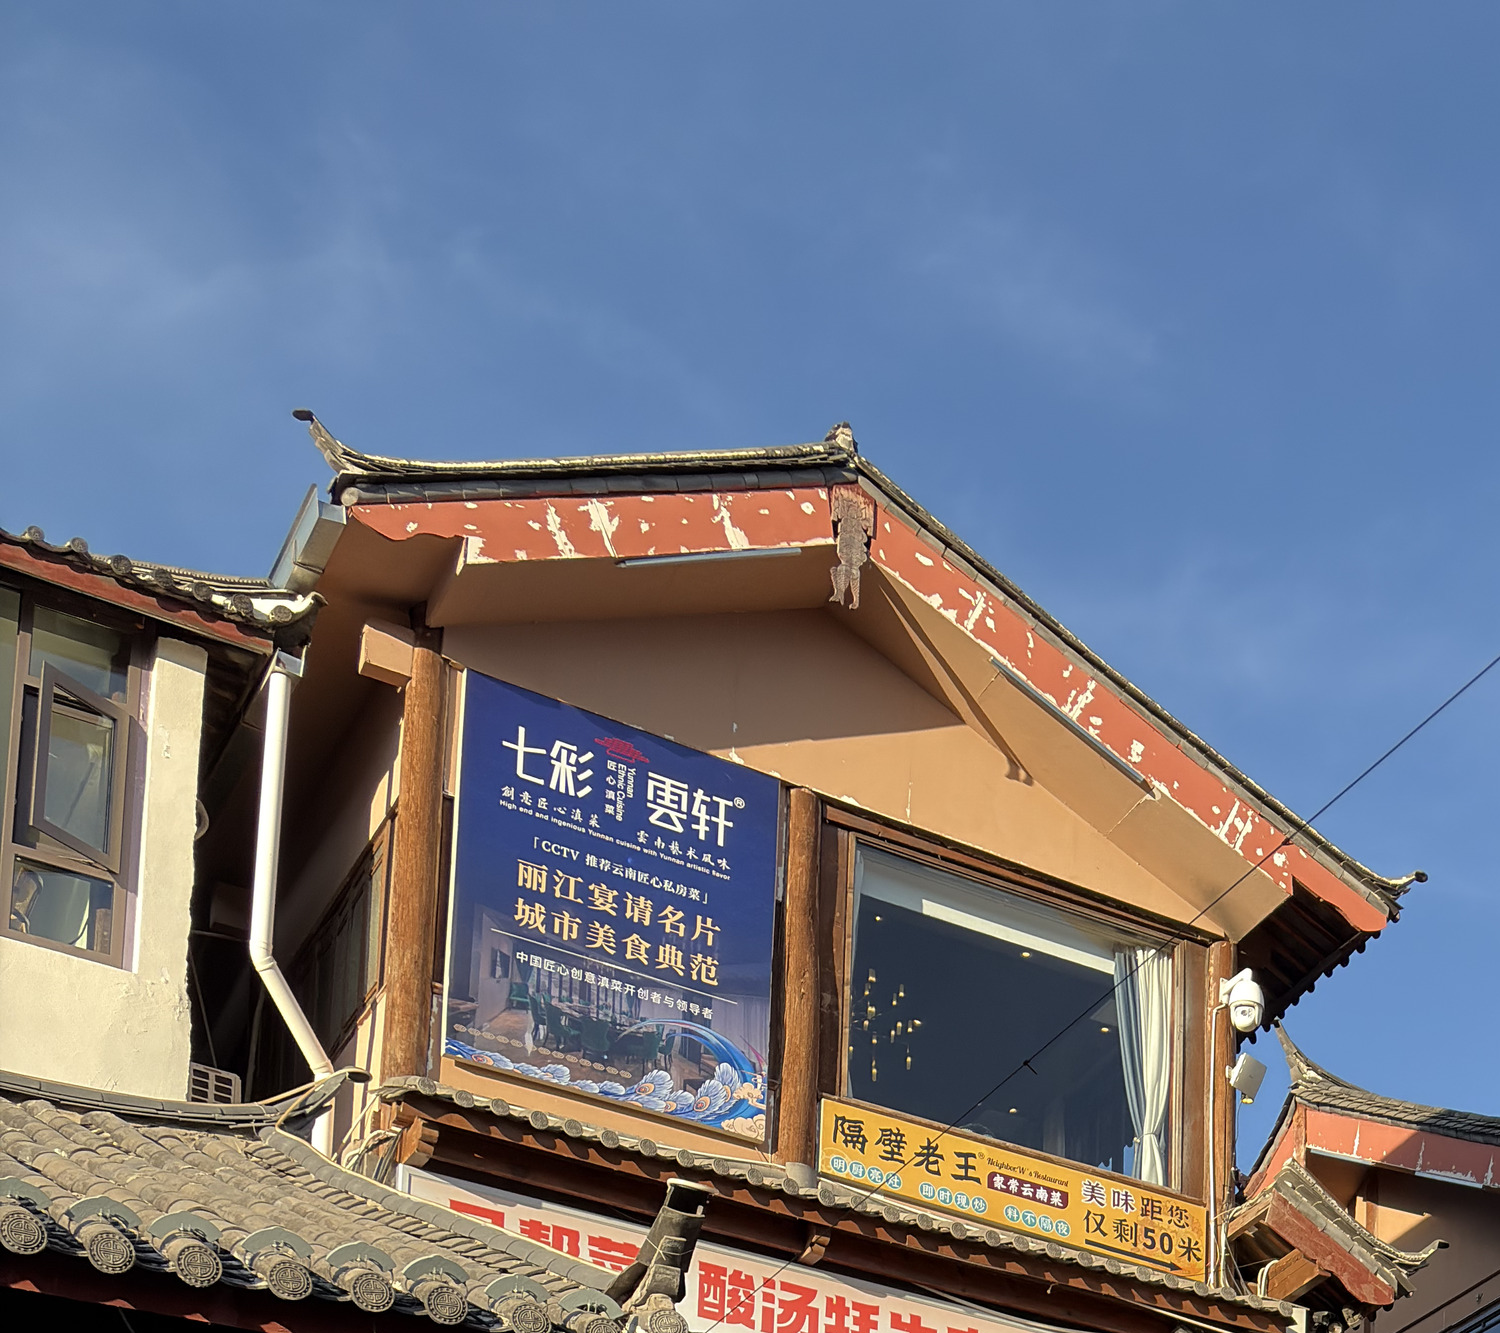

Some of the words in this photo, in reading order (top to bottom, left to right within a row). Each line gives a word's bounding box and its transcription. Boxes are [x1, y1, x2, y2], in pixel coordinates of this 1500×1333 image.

[502, 725, 595, 798] 七彩
[500, 799, 517, 811] High
[519, 806, 533, 816] end
[535, 811, 549, 821] and
[551, 815, 586, 834] ingenious
[588, 828, 614, 843] Yunnan
[616, 838, 641, 852] cuisine
[643, 844, 658, 857] with
[660, 851, 685, 866] Yunnan
[517, 858, 721, 946] 丽江宴请名片
[514, 897, 719, 987] 城市美食典范
[516, 951, 713, 1020] 中国匠心创意滇菜开创者与领导者
[832, 1114, 982, 1185] 隔壁老王
[831, 1156, 902, 1189] 明厨亮灶
[921, 1183, 987, 1214] 即时现炒
[1005, 1206, 1070, 1237] 料不隔夜
[992, 1174, 1064, 1208] 家常云南菜
[1080, 1179, 1190, 1229] 美味距您
[1083, 1208, 1202, 1263] 仅剩50米
